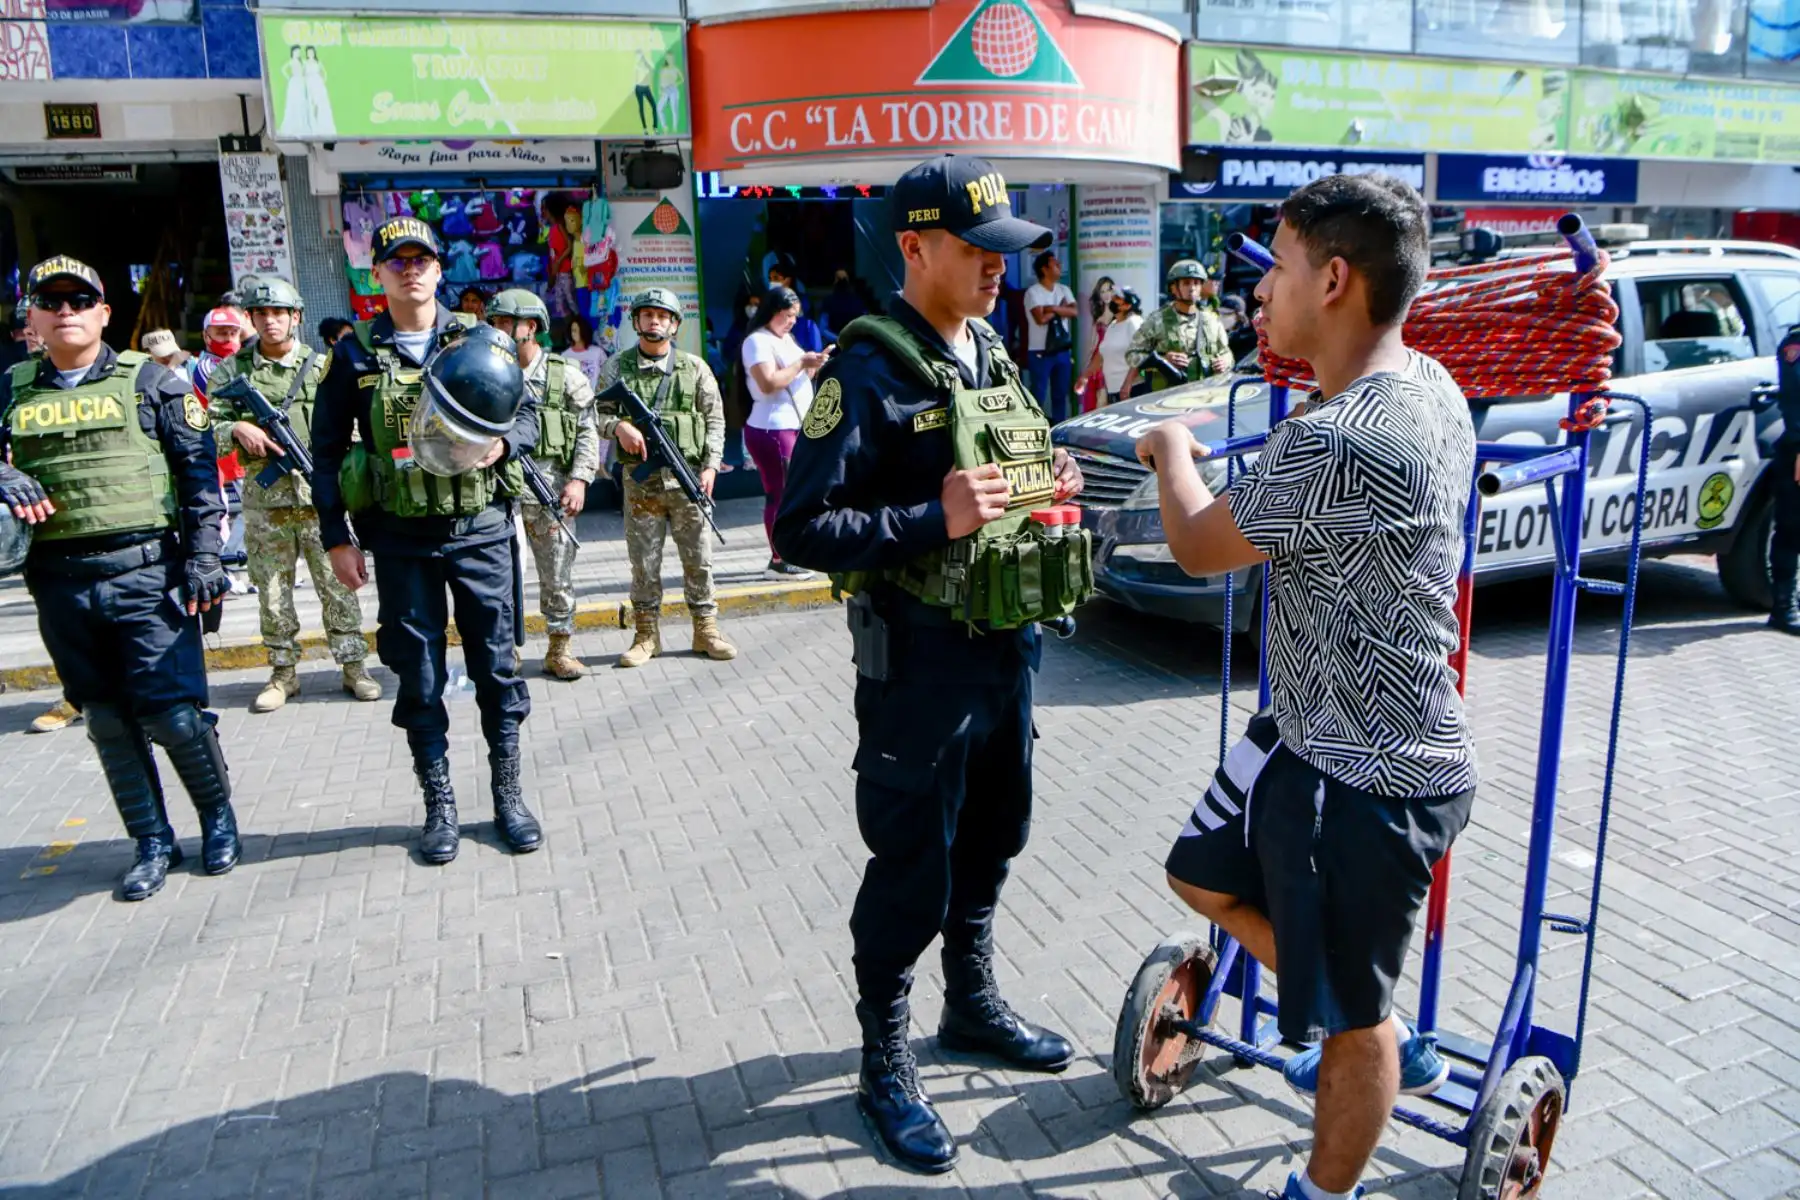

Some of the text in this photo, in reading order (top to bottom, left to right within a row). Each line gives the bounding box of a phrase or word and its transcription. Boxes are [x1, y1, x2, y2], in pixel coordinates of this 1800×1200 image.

[730, 111, 797, 153] C.C.
[882, 101, 1014, 143] TORRE
[1022, 101, 1070, 143] DE
[378, 146, 420, 165] Ropa
[429, 150, 459, 166] fina
[468, 148, 502, 163] para
[505, 146, 546, 164] Niños
[1483, 162, 1605, 195] ENSUEÑOS
[907, 208, 940, 224] PERU
[1465, 216, 1559, 234] LIQUIDACIÓ
[379, 219, 430, 247] POLICIA
[36, 256, 93, 281] POLICIA
[19, 395, 122, 431] POLICIA
[1006, 461, 1052, 495] POLICIA
[1477, 484, 1689, 554] ELOTN COBRA
